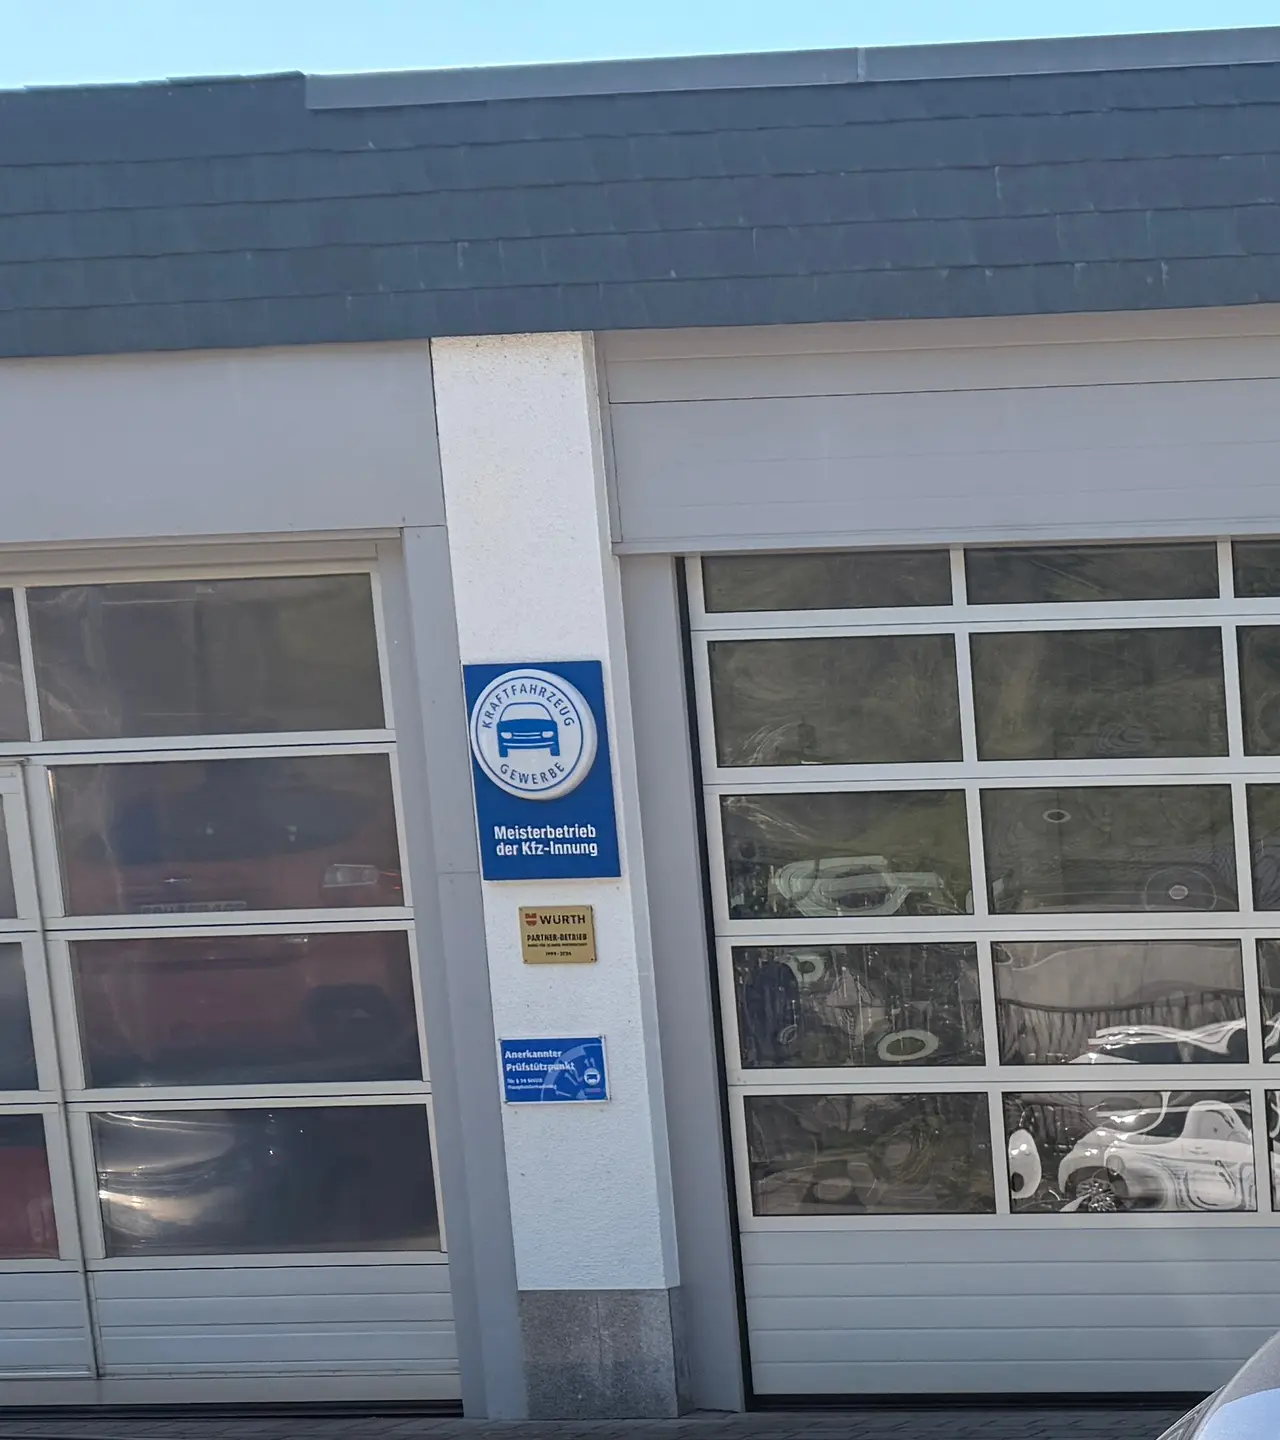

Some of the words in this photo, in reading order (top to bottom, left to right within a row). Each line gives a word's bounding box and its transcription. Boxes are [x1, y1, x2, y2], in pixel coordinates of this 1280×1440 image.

[482, 683, 575, 729] KRAFTFAHRZEUG
[500, 761, 565, 785] GEWERBE
[494, 824, 596, 840] Meisterbetrieb
[496, 842, 518, 856] der
[522, 840, 598, 856] Kfz-Innung
[505, 1050, 562, 1059] Anerkannter
[506, 1061, 575, 1072] Prüfstützpunkt
